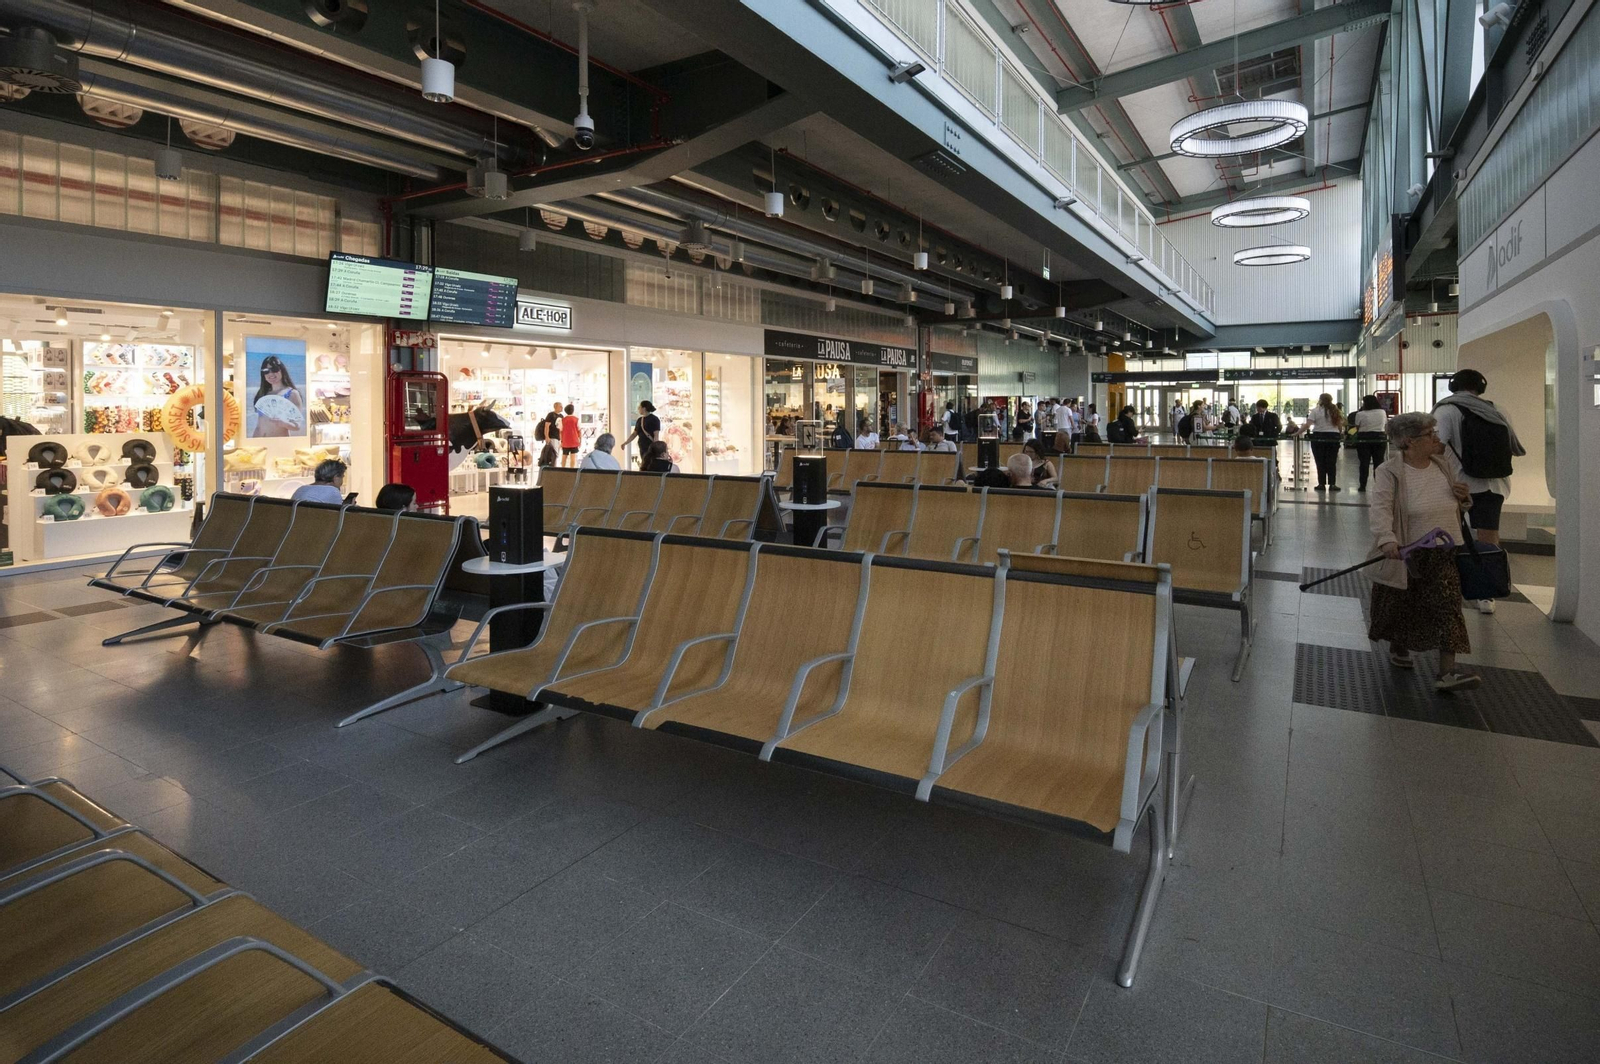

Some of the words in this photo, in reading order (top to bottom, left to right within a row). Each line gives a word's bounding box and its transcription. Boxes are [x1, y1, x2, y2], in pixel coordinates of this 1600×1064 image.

[1499, 219, 1523, 268] adif
[522, 308, 567, 323] ALE-HOP
[818, 343, 825, 354] LA
[826, 340, 851, 360] PAUSA
[881, 351, 886, 361] LA
[887, 348, 907, 366] PAUSA
[792, 367, 802, 377] LA
[168, 404, 191, 443] SUNSET
[1196, 422, 1201, 431] B
[188, 438, 201, 450] IS
